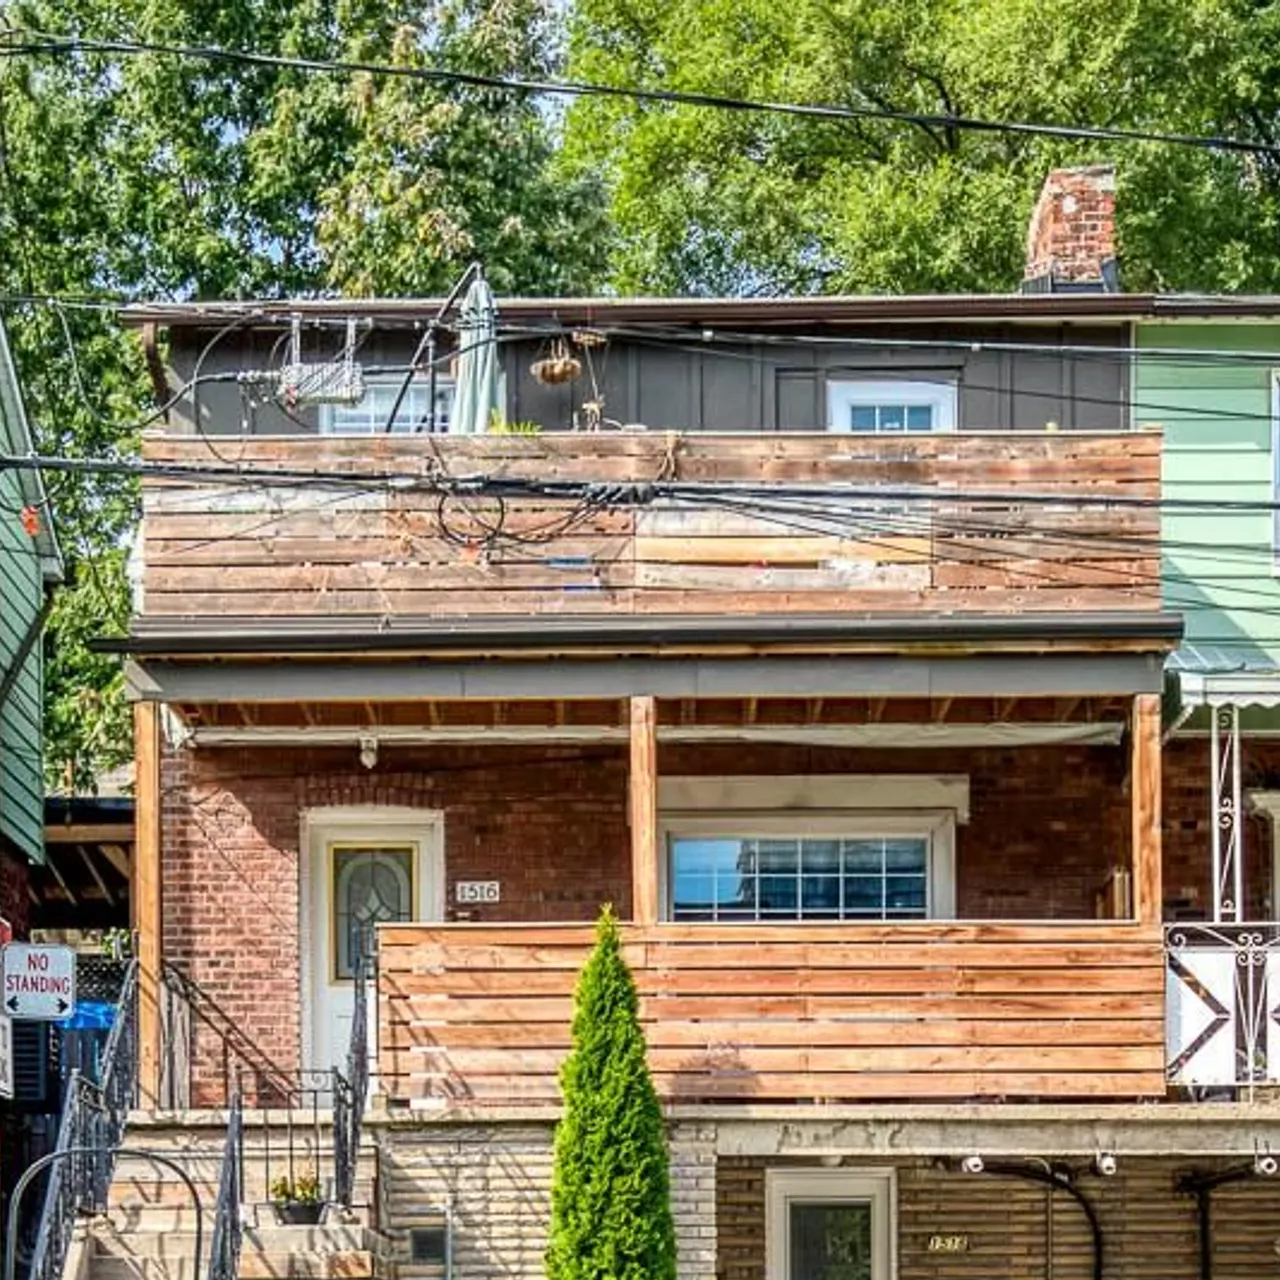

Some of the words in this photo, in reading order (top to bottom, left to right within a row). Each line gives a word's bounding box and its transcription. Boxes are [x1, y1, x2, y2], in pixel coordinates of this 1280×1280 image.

[460, 883, 498, 900] 1516
[27, 952, 49, 971] NO
[6, 974, 70, 994] STANDING
